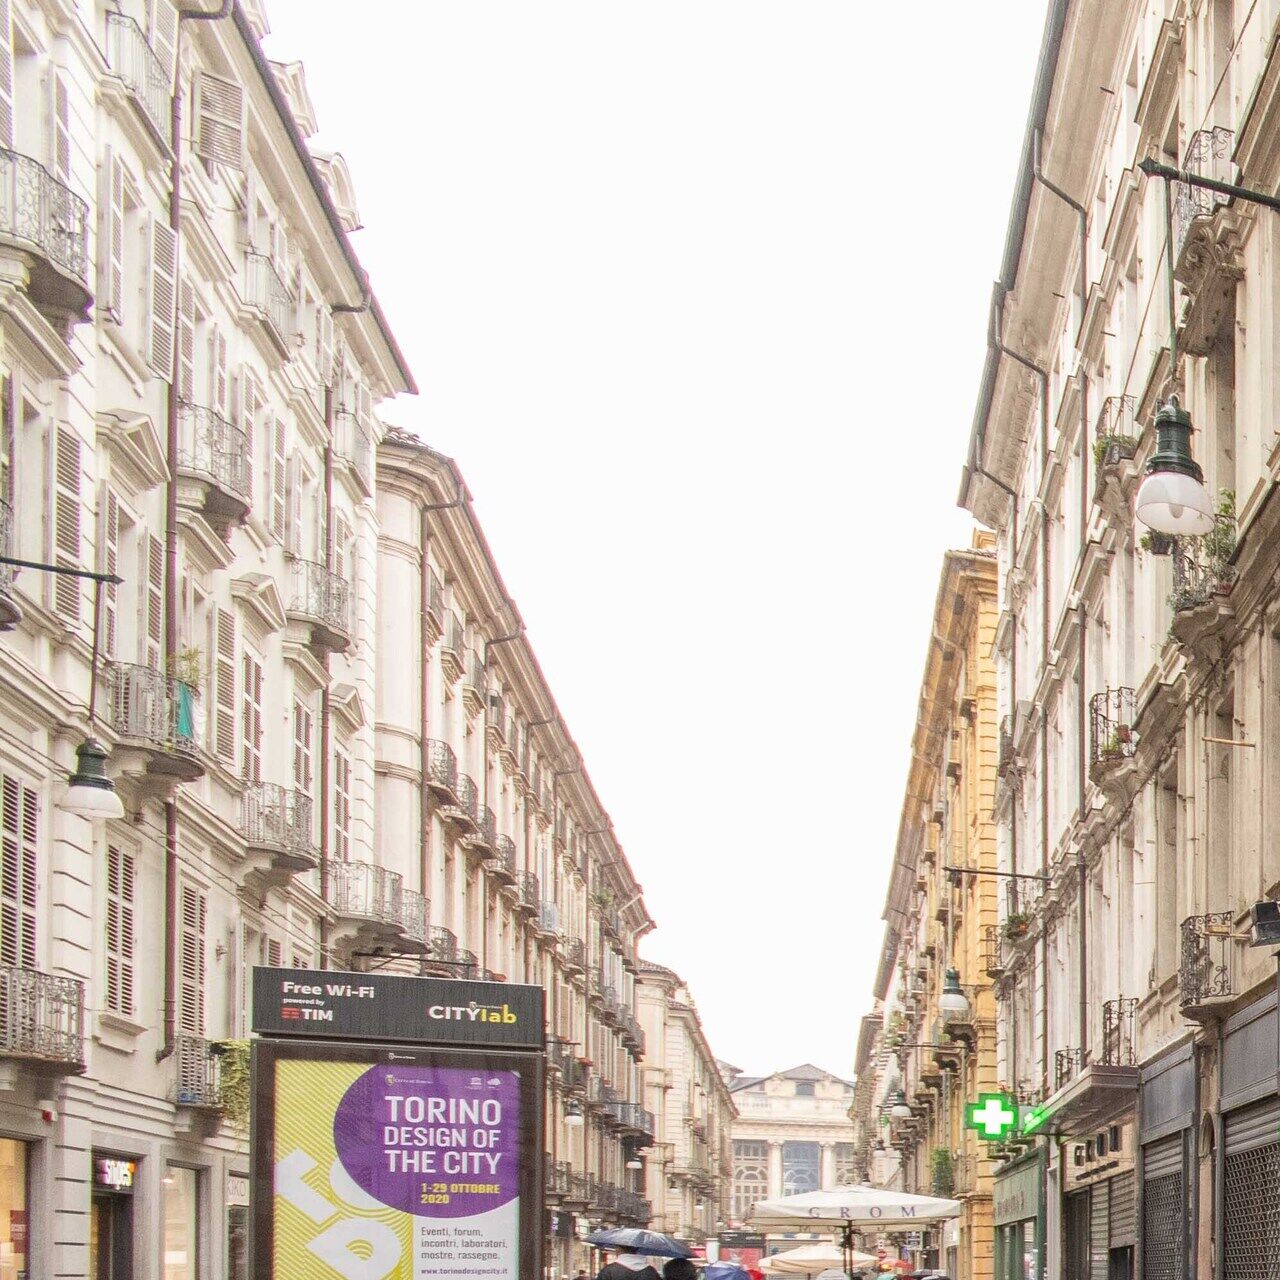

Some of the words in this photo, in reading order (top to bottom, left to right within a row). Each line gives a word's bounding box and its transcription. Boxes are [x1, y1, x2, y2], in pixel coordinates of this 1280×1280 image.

[283, 982, 322, 995] Free
[326, 984, 375, 998] Wi-Fi
[301, 1008, 333, 1021] TIM
[385, 1096, 501, 1125] TORINO
[385, 1127, 467, 1148] DESIGN
[472, 1129, 501, 1148] OF
[385, 1150, 436, 1173] THE
[443, 1152, 501, 1175] CITY
[421, 1183, 448, 1193] 1-29
[451, 1184, 500, 1194] OTTOBRE
[421, 1194, 450, 1204] 2020
[421, 1227, 451, 1237] Eventi,
[454, 1227, 484, 1237] forum,
[421, 1239, 459, 1249] incontri,
[461, 1240, 508, 1249] laboratori,
[421, 1252, 456, 1260] mostre,
